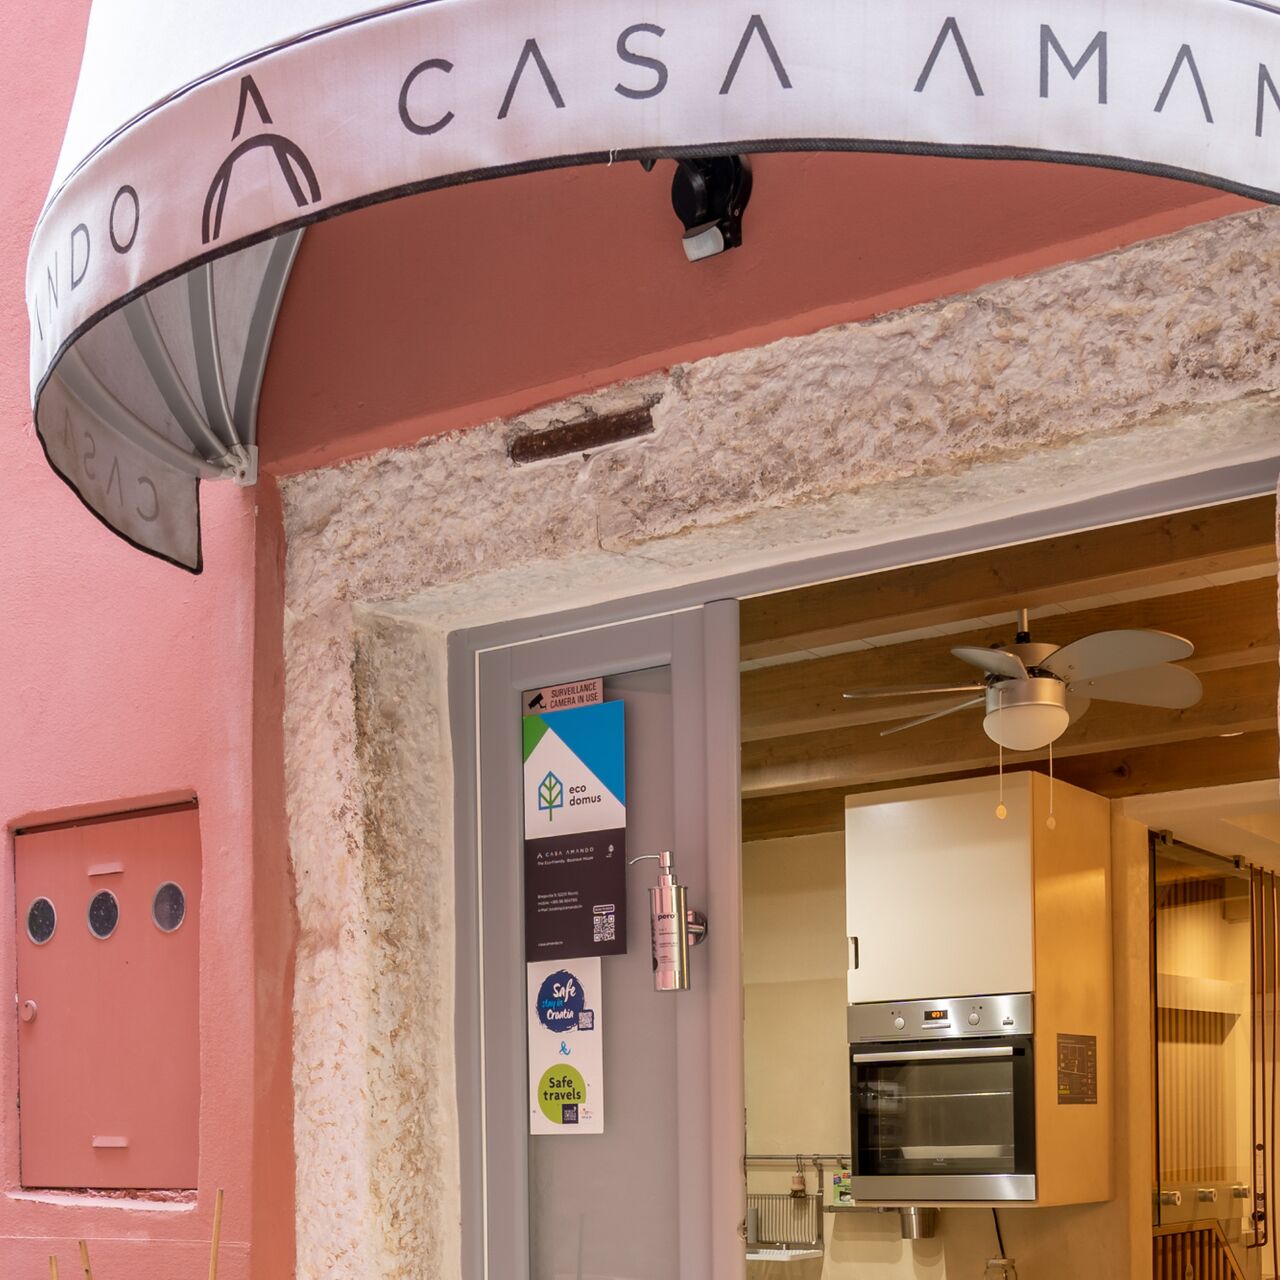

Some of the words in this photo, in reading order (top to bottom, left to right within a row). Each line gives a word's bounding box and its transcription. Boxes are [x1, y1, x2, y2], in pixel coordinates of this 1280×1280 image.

[397, 14, 793, 136] CASA
[551, 681, 597, 699] SURVEILLANCE
[550, 697, 576, 709] CAMERA
[577, 694, 585, 704] IN
[585, 692, 598, 702] USE
[568, 784, 587, 794] eco
[569, 794, 602, 807] domus
[657, 913, 675, 921] pero
[552, 978, 577, 1003] Safe
[546, 1008, 574, 1020] Croatia
[548, 1075, 573, 1089] Safe
[543, 1087, 582, 1101] travels
